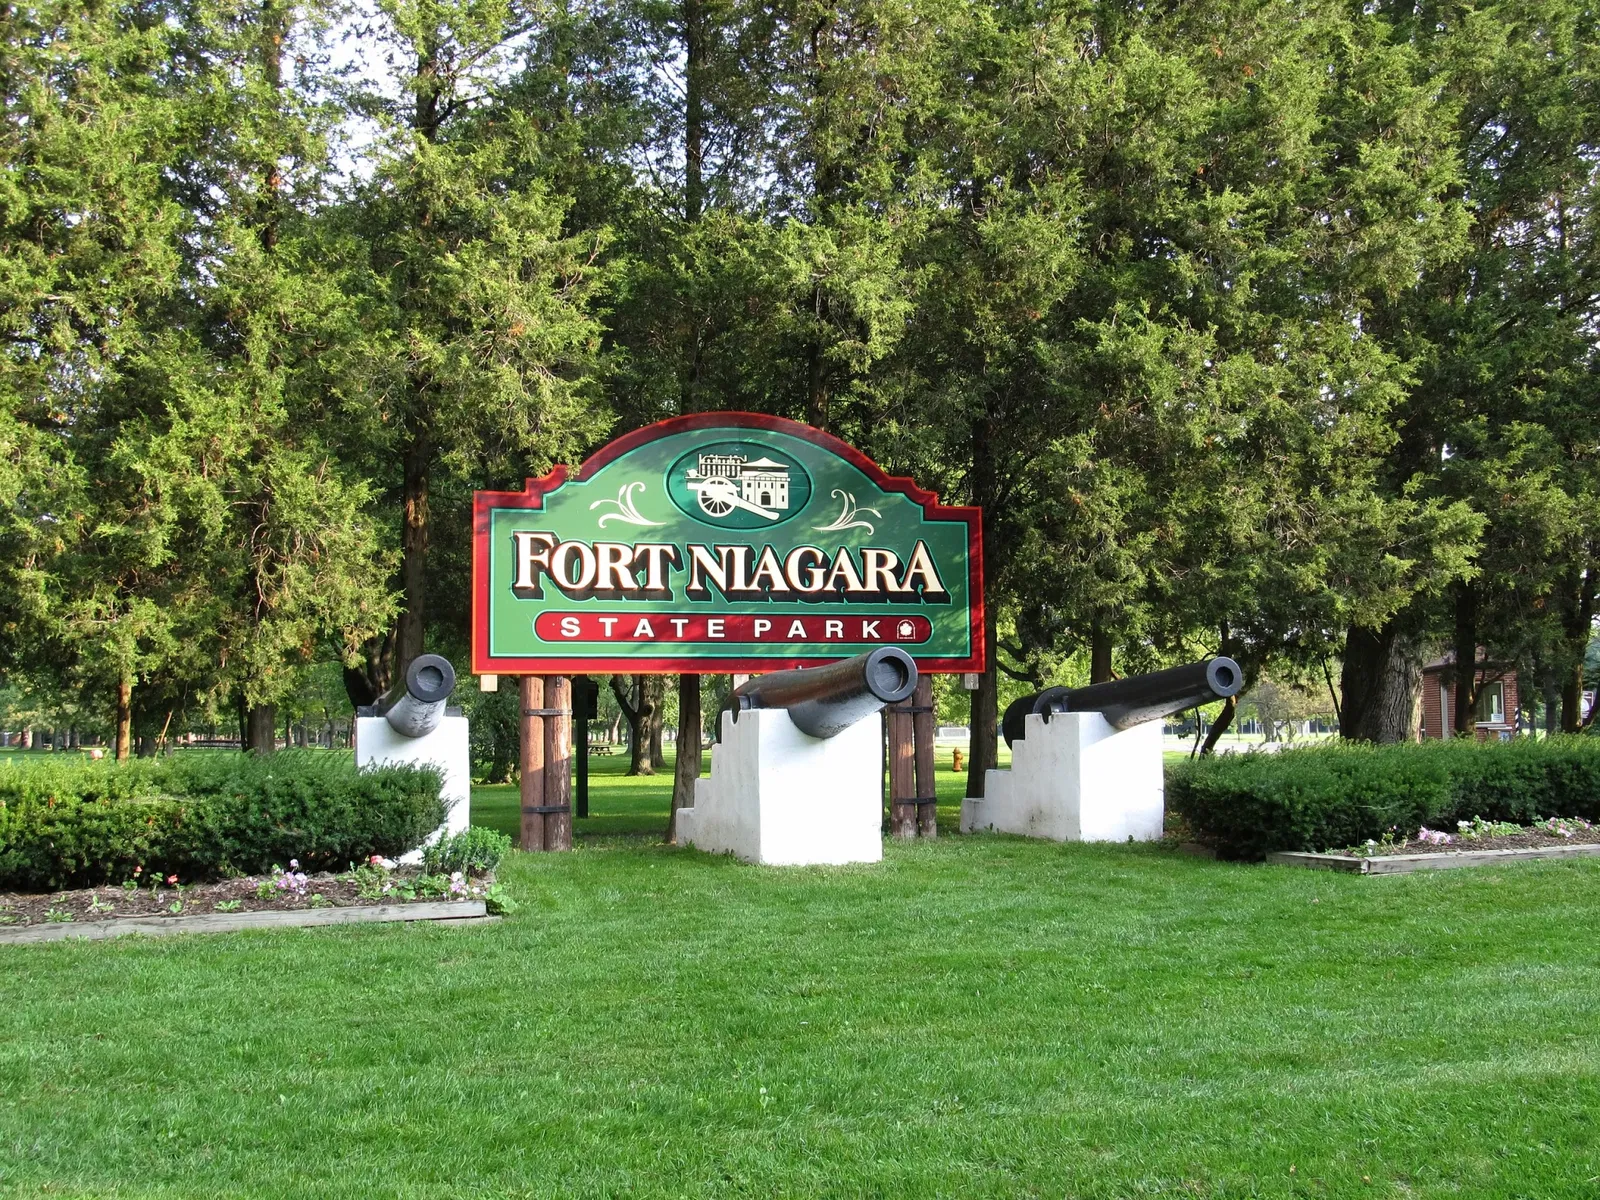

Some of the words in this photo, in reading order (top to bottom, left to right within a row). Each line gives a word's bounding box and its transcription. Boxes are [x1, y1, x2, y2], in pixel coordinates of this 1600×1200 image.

[513, 531, 678, 592] FORT
[687, 539, 945, 593] NIAGARA
[560, 616, 726, 638] STATE
[754, 618, 882, 639] PARK
